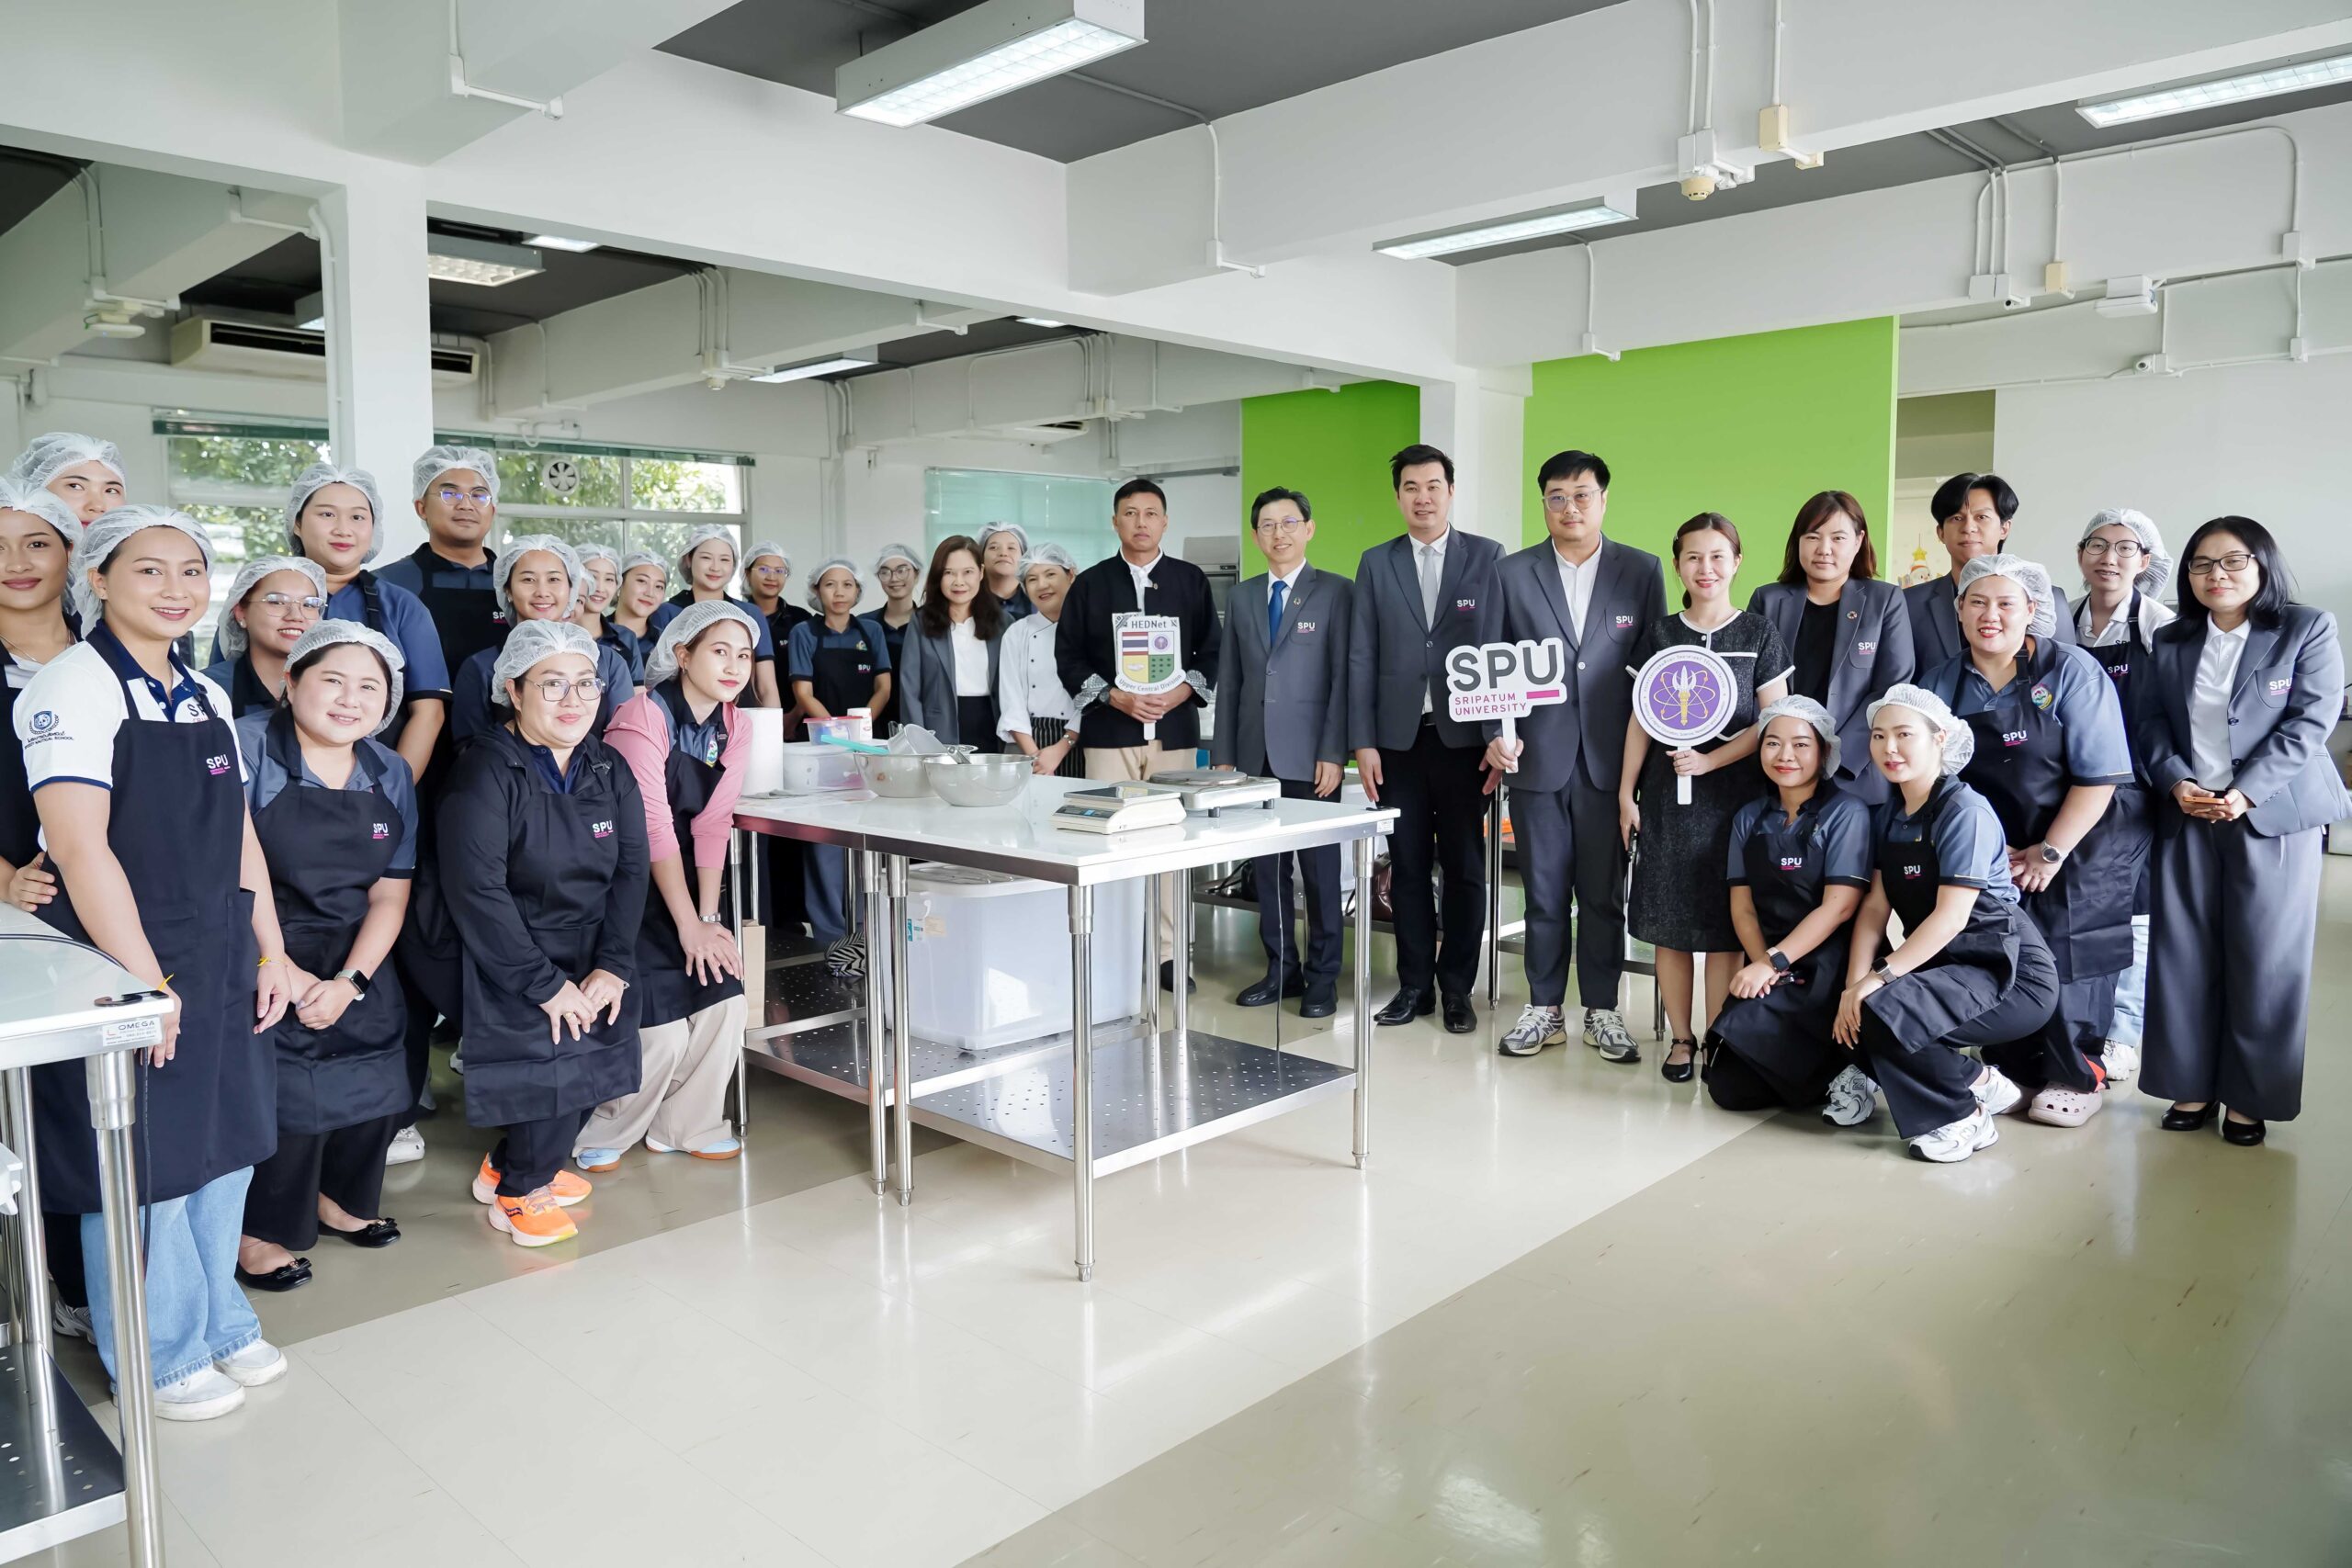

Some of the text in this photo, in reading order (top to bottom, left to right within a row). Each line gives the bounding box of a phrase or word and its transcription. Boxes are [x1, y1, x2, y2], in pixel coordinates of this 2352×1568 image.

[1456, 599, 1476, 608] SPU
[492, 611, 505, 619] SP
[1615, 615, 1634, 624] SPU
[1131, 619, 1166, 628] HEDNet
[1297, 622, 1316, 630] SPU
[1858, 641, 1876, 650] SPU
[1452, 644, 1558, 692] SPU
[2107, 663, 2129, 673] SPU
[1118, 678, 1136, 690] Upper
[1159, 674, 1182, 690] Division
[2269, 677, 2292, 690] SPU
[1454, 693, 1516, 705] SRIPATUM
[1454, 703, 1526, 716] UNIVERSITY
[2003, 729, 2028, 741] SPU
[206, 753, 230, 769] SPU
[373, 822, 389, 833] SPU
[592, 819, 613, 833] SPU
[1781, 857, 1803, 866] SPU
[1903, 864, 1921, 874] SPU
[118, 1021, 155, 1030] OMEGA
